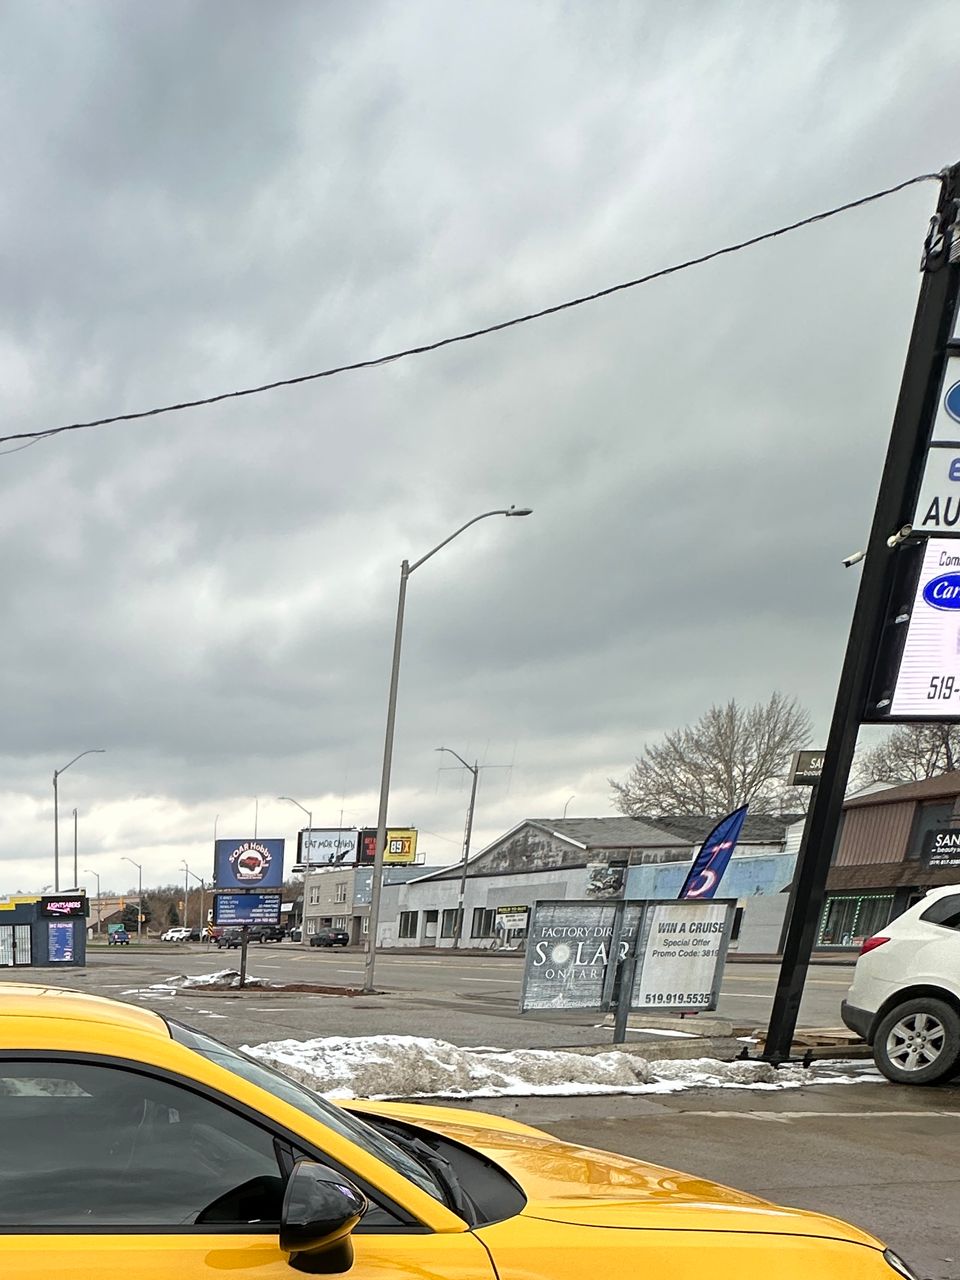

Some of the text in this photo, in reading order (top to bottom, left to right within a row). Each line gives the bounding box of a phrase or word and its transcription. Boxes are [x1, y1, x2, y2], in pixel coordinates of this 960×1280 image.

[304, 840, 318, 849] EAT
[318, 839, 333, 849] MOR
[228, 842, 273, 864] SOAR Hobby
[541, 926, 634, 937] FACTORY DIRCT
[658, 922, 725, 934] WIN A CRUISE
[663, 938, 711, 948] Special Offer
[652, 949, 677, 958] Promo
[678, 949, 701, 958] Code:
[545, 968, 612, 979] ONTARI
[645, 993, 711, 1004] 519.919.5535
